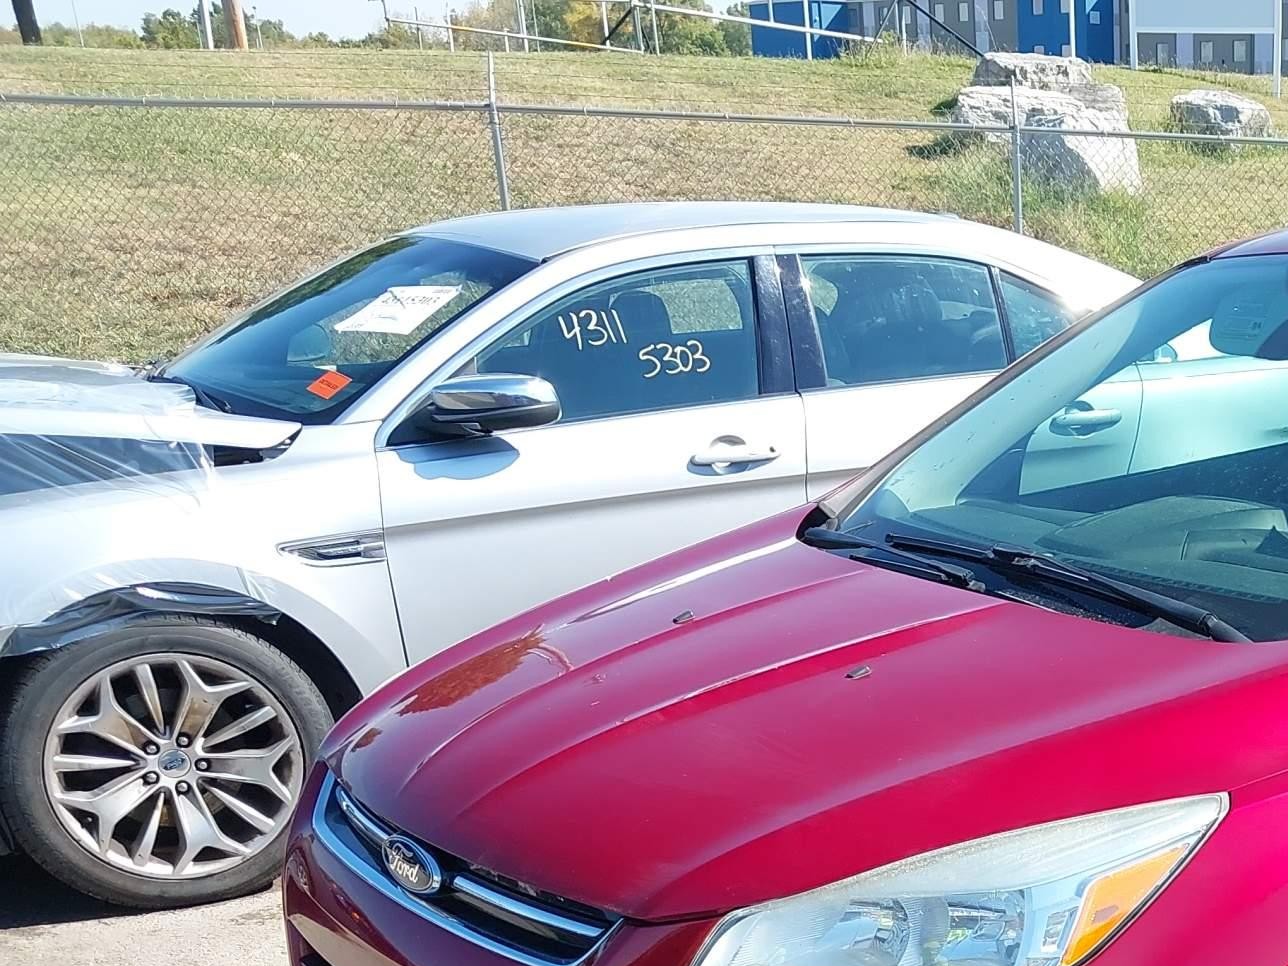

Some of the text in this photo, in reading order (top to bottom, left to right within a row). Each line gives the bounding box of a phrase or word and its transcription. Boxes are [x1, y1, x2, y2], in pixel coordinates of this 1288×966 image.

[558, 309, 628, 350] 4311
[639, 340, 711, 378] 5303
[389, 842, 419, 883] Ford
